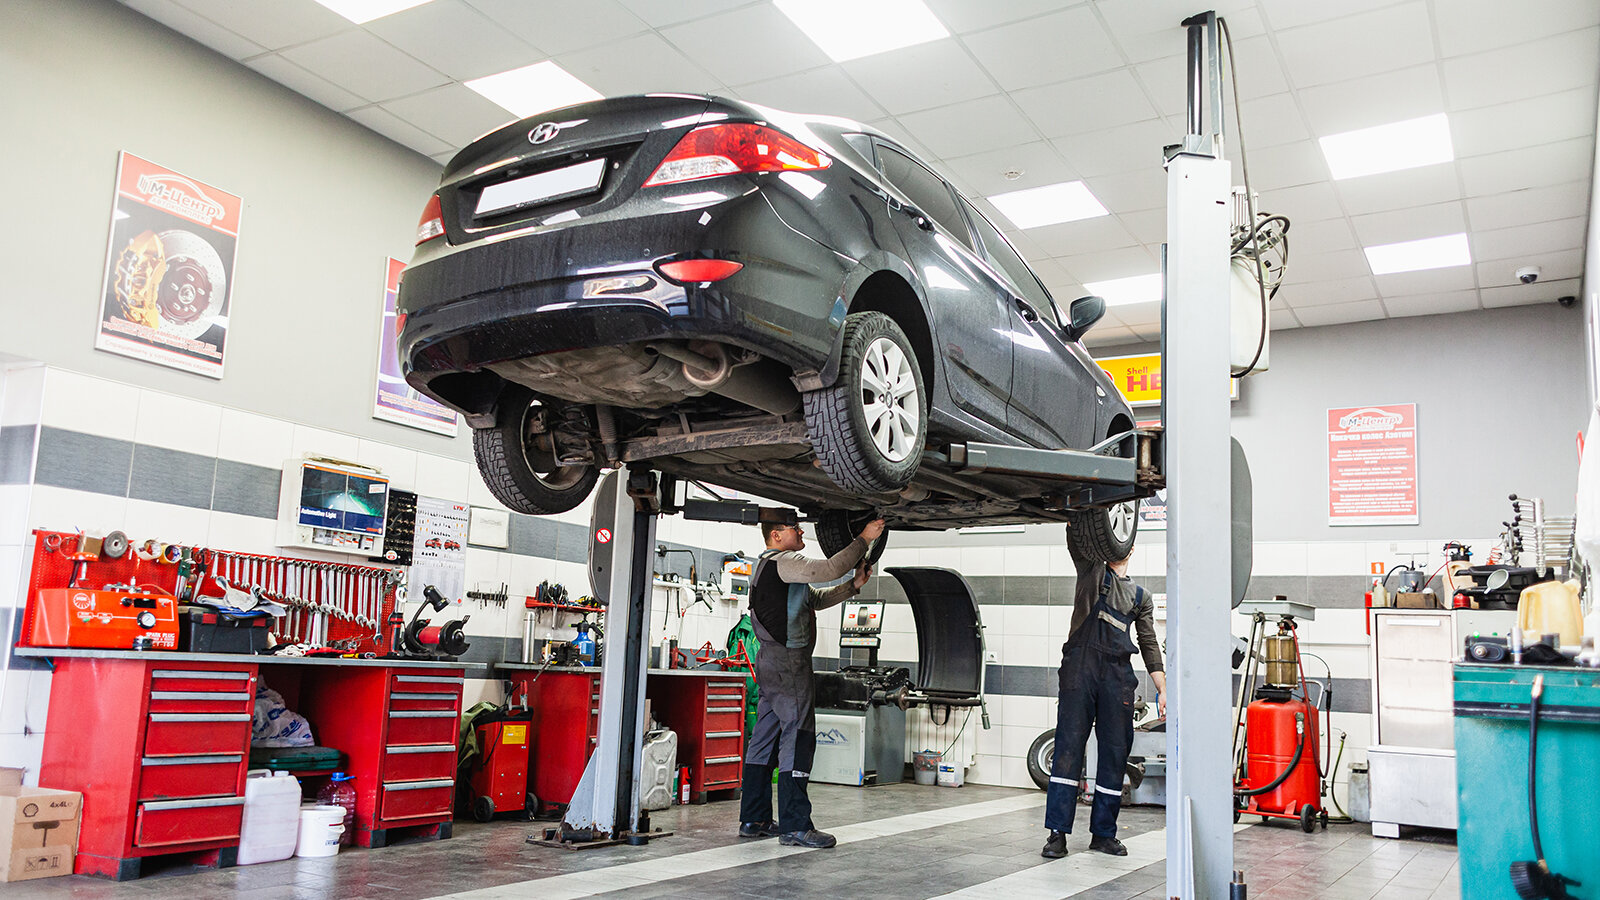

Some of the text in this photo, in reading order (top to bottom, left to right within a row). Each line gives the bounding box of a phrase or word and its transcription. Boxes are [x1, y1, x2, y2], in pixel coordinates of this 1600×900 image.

[150, 182, 216, 218] М-Центр
[1127, 366, 1148, 375] Shell
[1127, 374, 1161, 392] HE
[1348, 416, 1396, 425] М-Центр
[300, 507, 337, 519] Automotive Light
